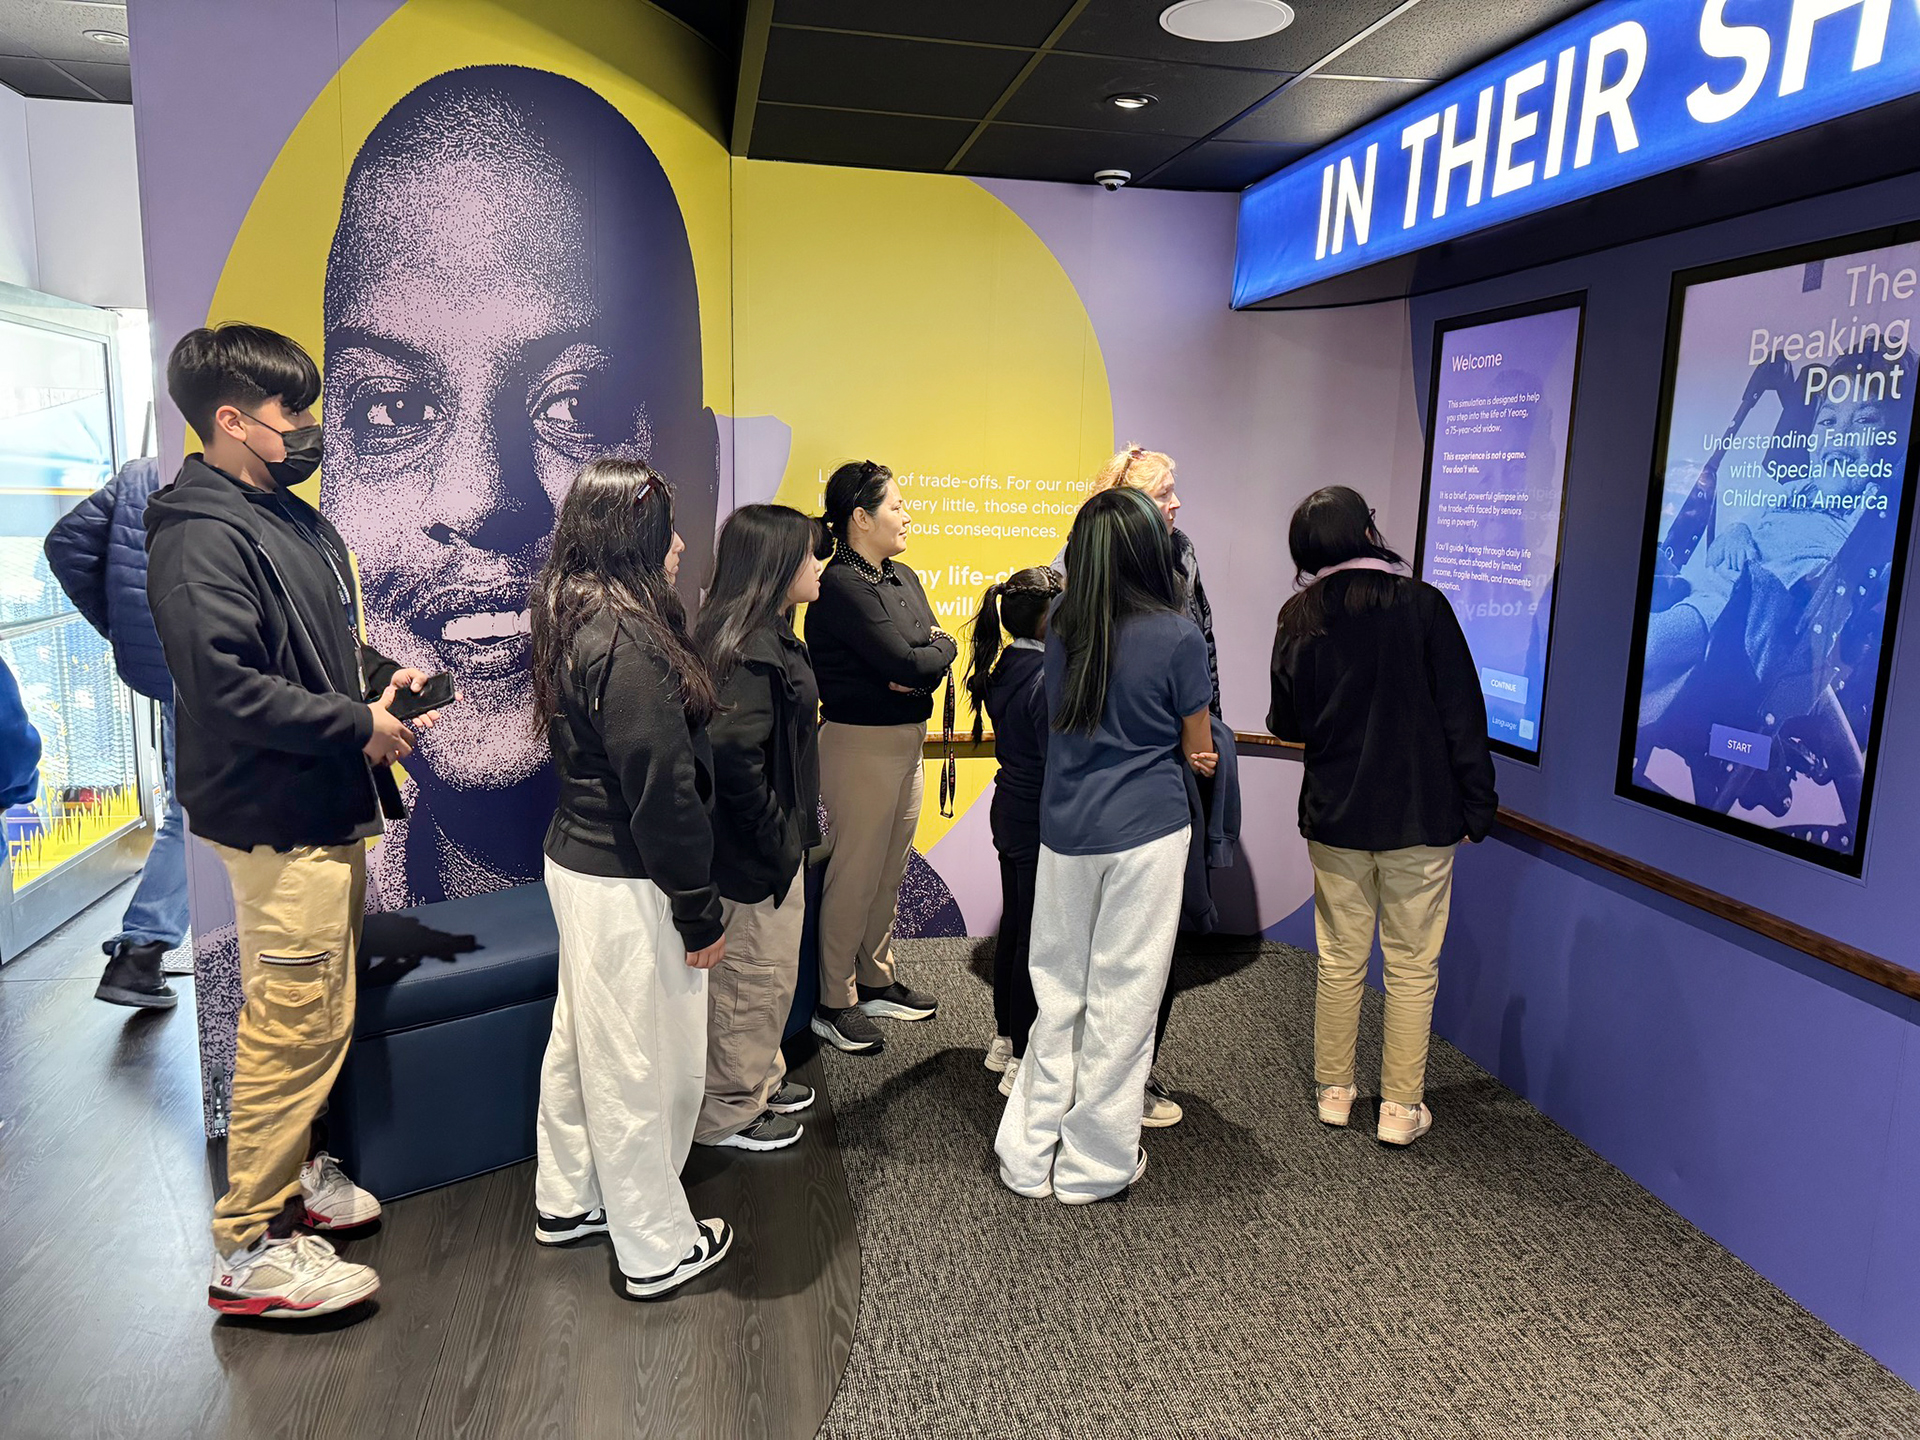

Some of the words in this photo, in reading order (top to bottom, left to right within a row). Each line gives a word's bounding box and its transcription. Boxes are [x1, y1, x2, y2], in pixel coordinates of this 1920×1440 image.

[1314, 142, 1379, 261] IN
[1401, 20, 1648, 230] THEIR
[1686, 0, 1920, 124] SH
[1846, 263, 1917, 307] The
[1748, 316, 1911, 366] Breaking
[1452, 353, 1502, 372] Welcome
[1804, 363, 1905, 406] Point
[1448, 400, 1458, 408] This
[1459, 398, 1486, 408] simulation
[1487, 397, 1491, 405] is
[1492, 394, 1518, 406] designed
[1519, 394, 1525, 402] to
[1527, 392, 1540, 403] help
[1446, 416, 1456, 424] you
[1457, 413, 1468, 422] step
[1469, 412, 1479, 420] into
[1480, 411, 1489, 419] the
[1490, 410, 1499, 418] life
[1500, 408, 1507, 417] of
[1508, 408, 1528, 419] Yeong,
[1450, 424, 1482, 436] 75-year-old
[1482, 424, 1502, 432] widow.
[1703, 430, 1819, 452] Understanding
[1824, 426, 1897, 447] Families
[1444, 452, 1454, 460] This
[1455, 452, 1485, 462] experience
[1486, 451, 1490, 460] is
[1491, 451, 1501, 460] not
[1507, 452, 1526, 461] game.
[1442, 465, 1452, 473] You
[1453, 465, 1467, 473] don't
[1468, 465, 1479, 473] win.
[1730, 461, 1762, 478] with
[1766, 459, 1828, 482] Special
[1832, 458, 1893, 478] Needs
[898, 472, 914, 486] of
[919, 474, 1002, 490] trade-offs.
[1006, 476, 1031, 490] For
[1036, 479, 1061, 491] our
[1454, 491, 1467, 500] brief,
[1468, 492, 1493, 501] powerful
[1493, 493, 1516, 503] glimpse
[1517, 492, 1529, 501] into
[1722, 489, 1787, 508] Children
[1792, 490, 1806, 508] in
[1812, 490, 1888, 510] America
[903, 499, 938, 514] very
[942, 497, 979, 514] little,
[984, 499, 1027, 513] those
[1439, 504, 1447, 512] the
[1448, 505, 1475, 513] trade-offs
[1476, 505, 1492, 514] faced
[1493, 505, 1500, 516] by
[1501, 507, 1522, 516] seniors
[1437, 517, 1450, 527] living
[1451, 517, 1456, 525] in
[1456, 519, 1478, 528] poverty.
[944, 524, 1060, 539] consequences.
[1435, 542, 1448, 550] You'll
[1449, 544, 1464, 553] guide
[1465, 544, 1482, 555] Yeong
[1483, 546, 1505, 557] through
[1506, 548, 1520, 559] daily
[1521, 549, 1531, 558] life
[1434, 555, 1458, 565] decisions,
[1458, 558, 1471, 566] each
[1472, 558, 1492, 569] shaped
[1493, 560, 1500, 571] by
[1501, 561, 1521, 571] limited
[1431, 579, 1438, 587] of
[1438, 581, 1460, 591] isolation.
[1432, 568, 1452, 577] income,
[1453, 569, 1470, 580] fragile
[1471, 571, 1490, 582] health,
[1491, 575, 1502, 583] and
[1503, 577, 1531, 587] moments
[935, 596, 973, 616] will
[1490, 679, 1516, 692] CONTINUE
[1727, 739, 1752, 754] START
